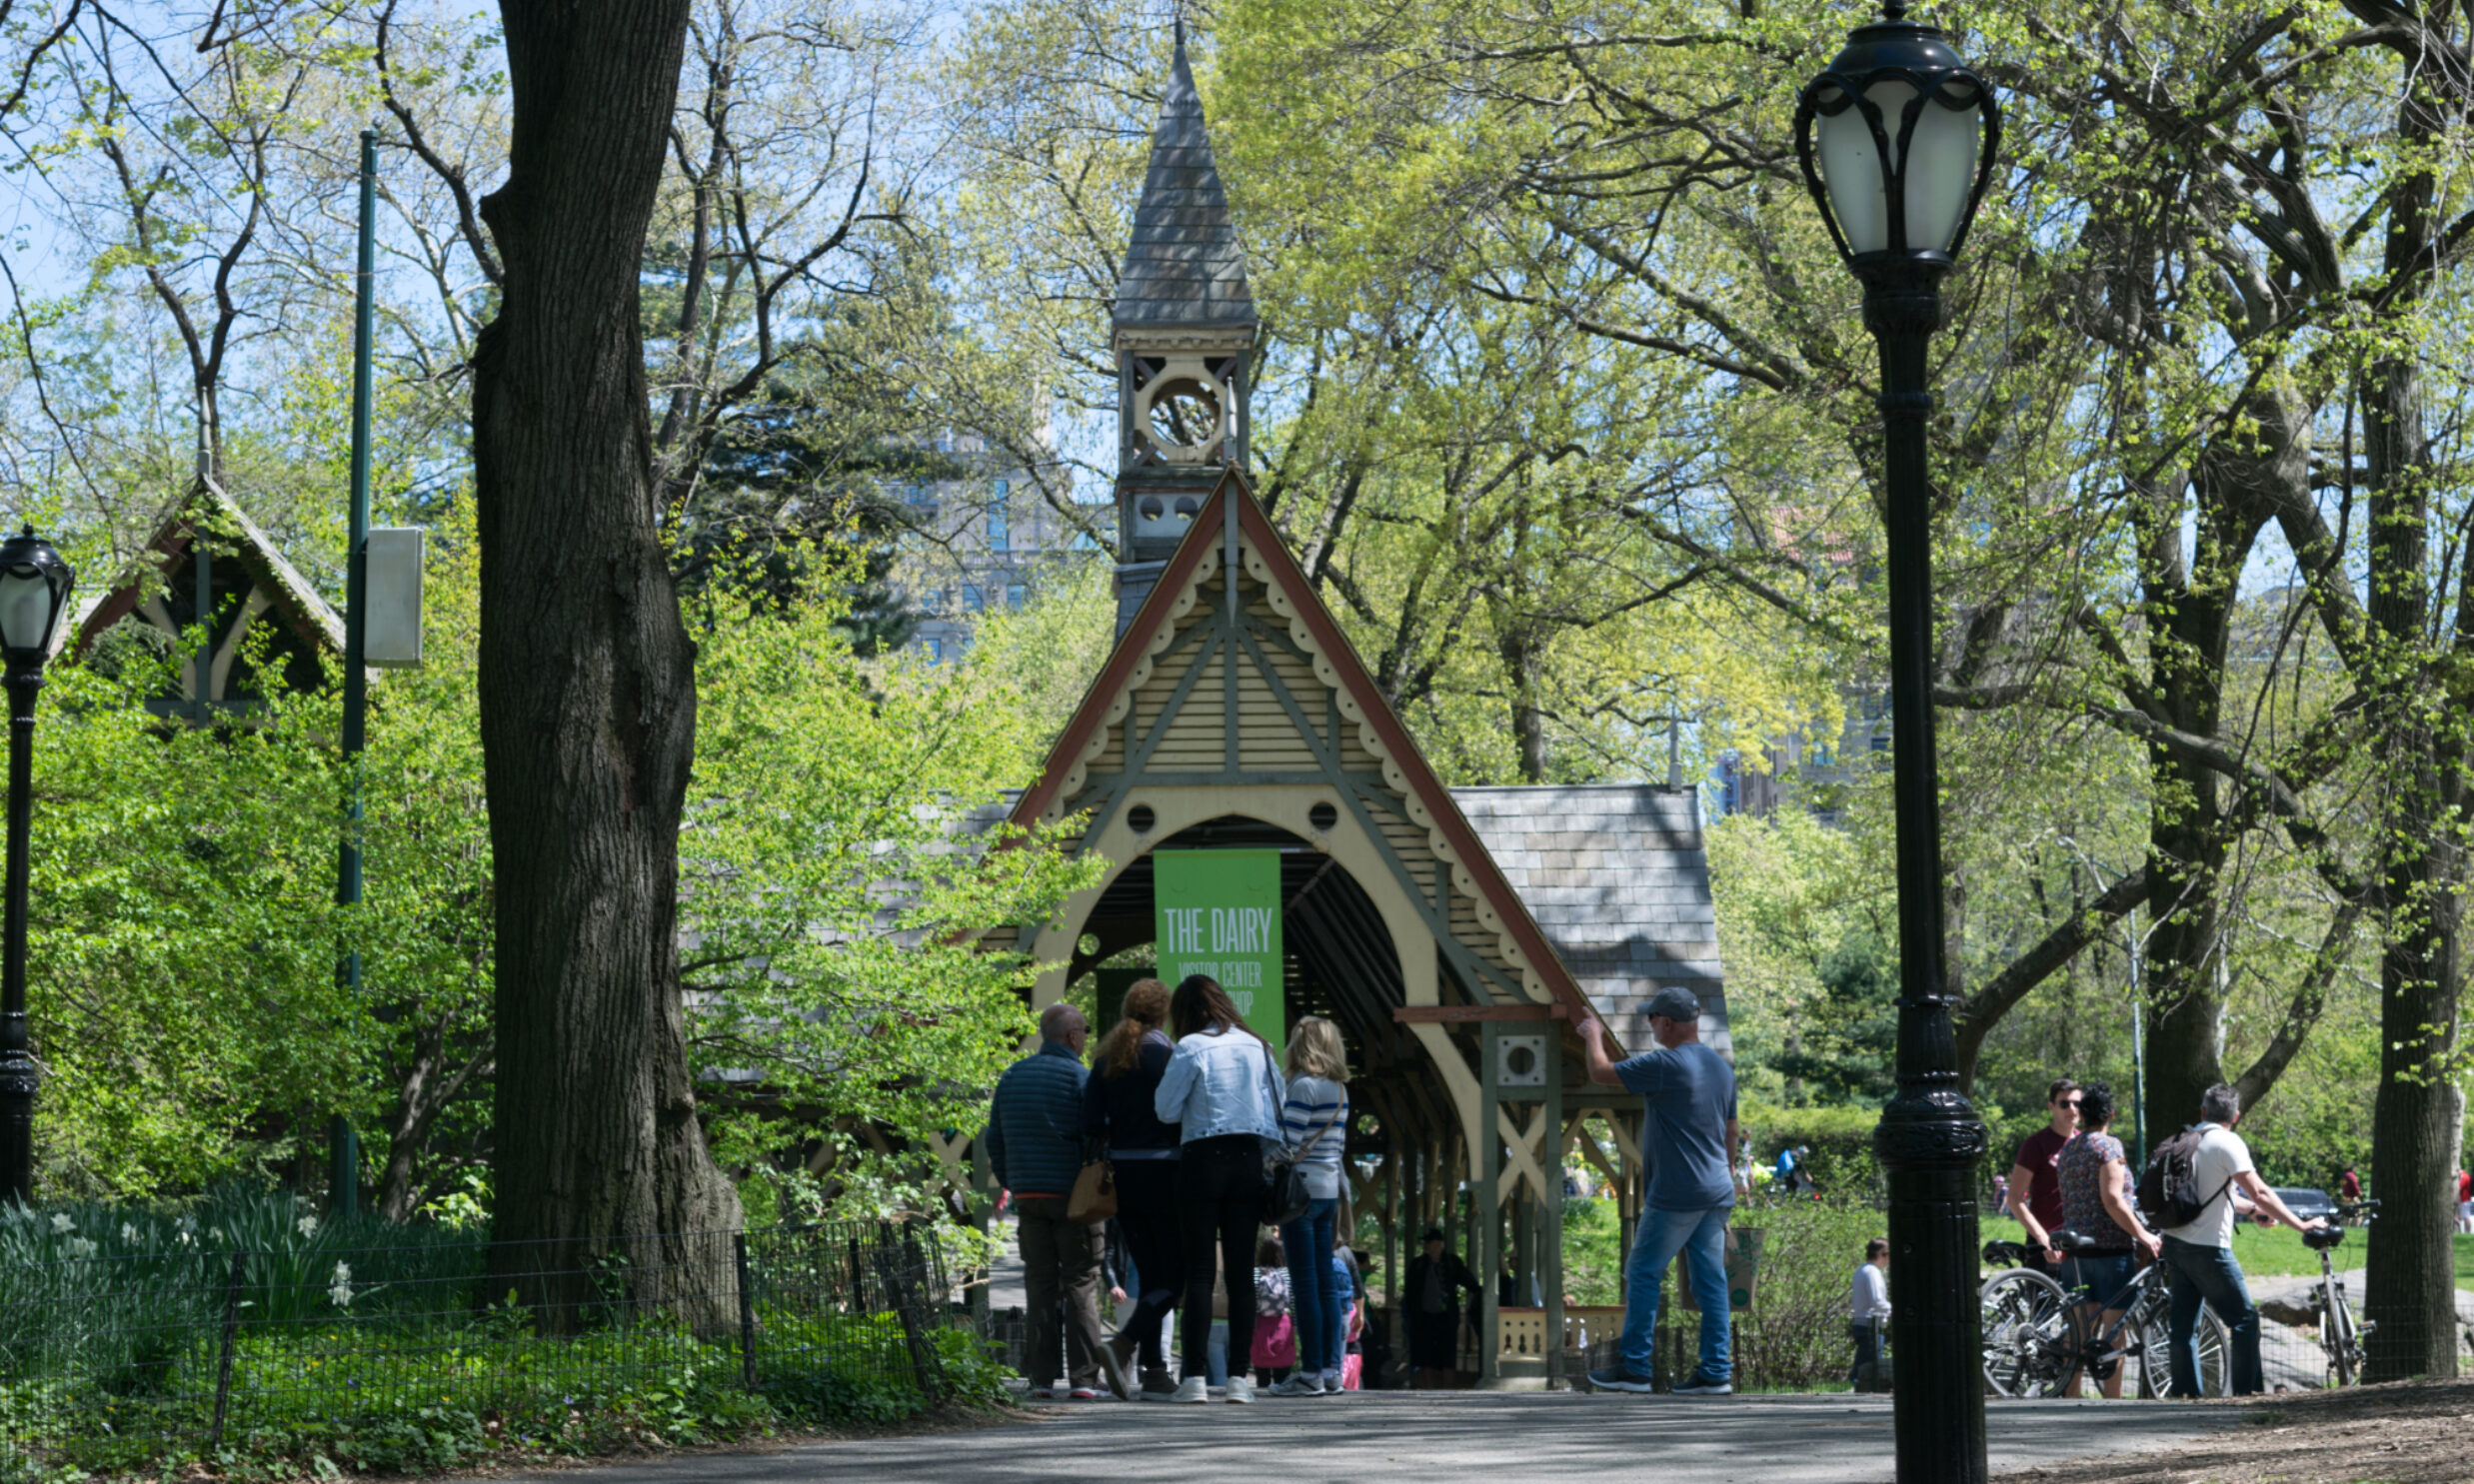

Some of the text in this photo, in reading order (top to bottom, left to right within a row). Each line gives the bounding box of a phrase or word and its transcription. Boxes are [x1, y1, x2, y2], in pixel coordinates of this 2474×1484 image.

[1164, 907, 1272, 953] THE DAIRY
[1223, 961, 1262, 987] CENTER
[1227, 990, 1253, 1016] HOP
